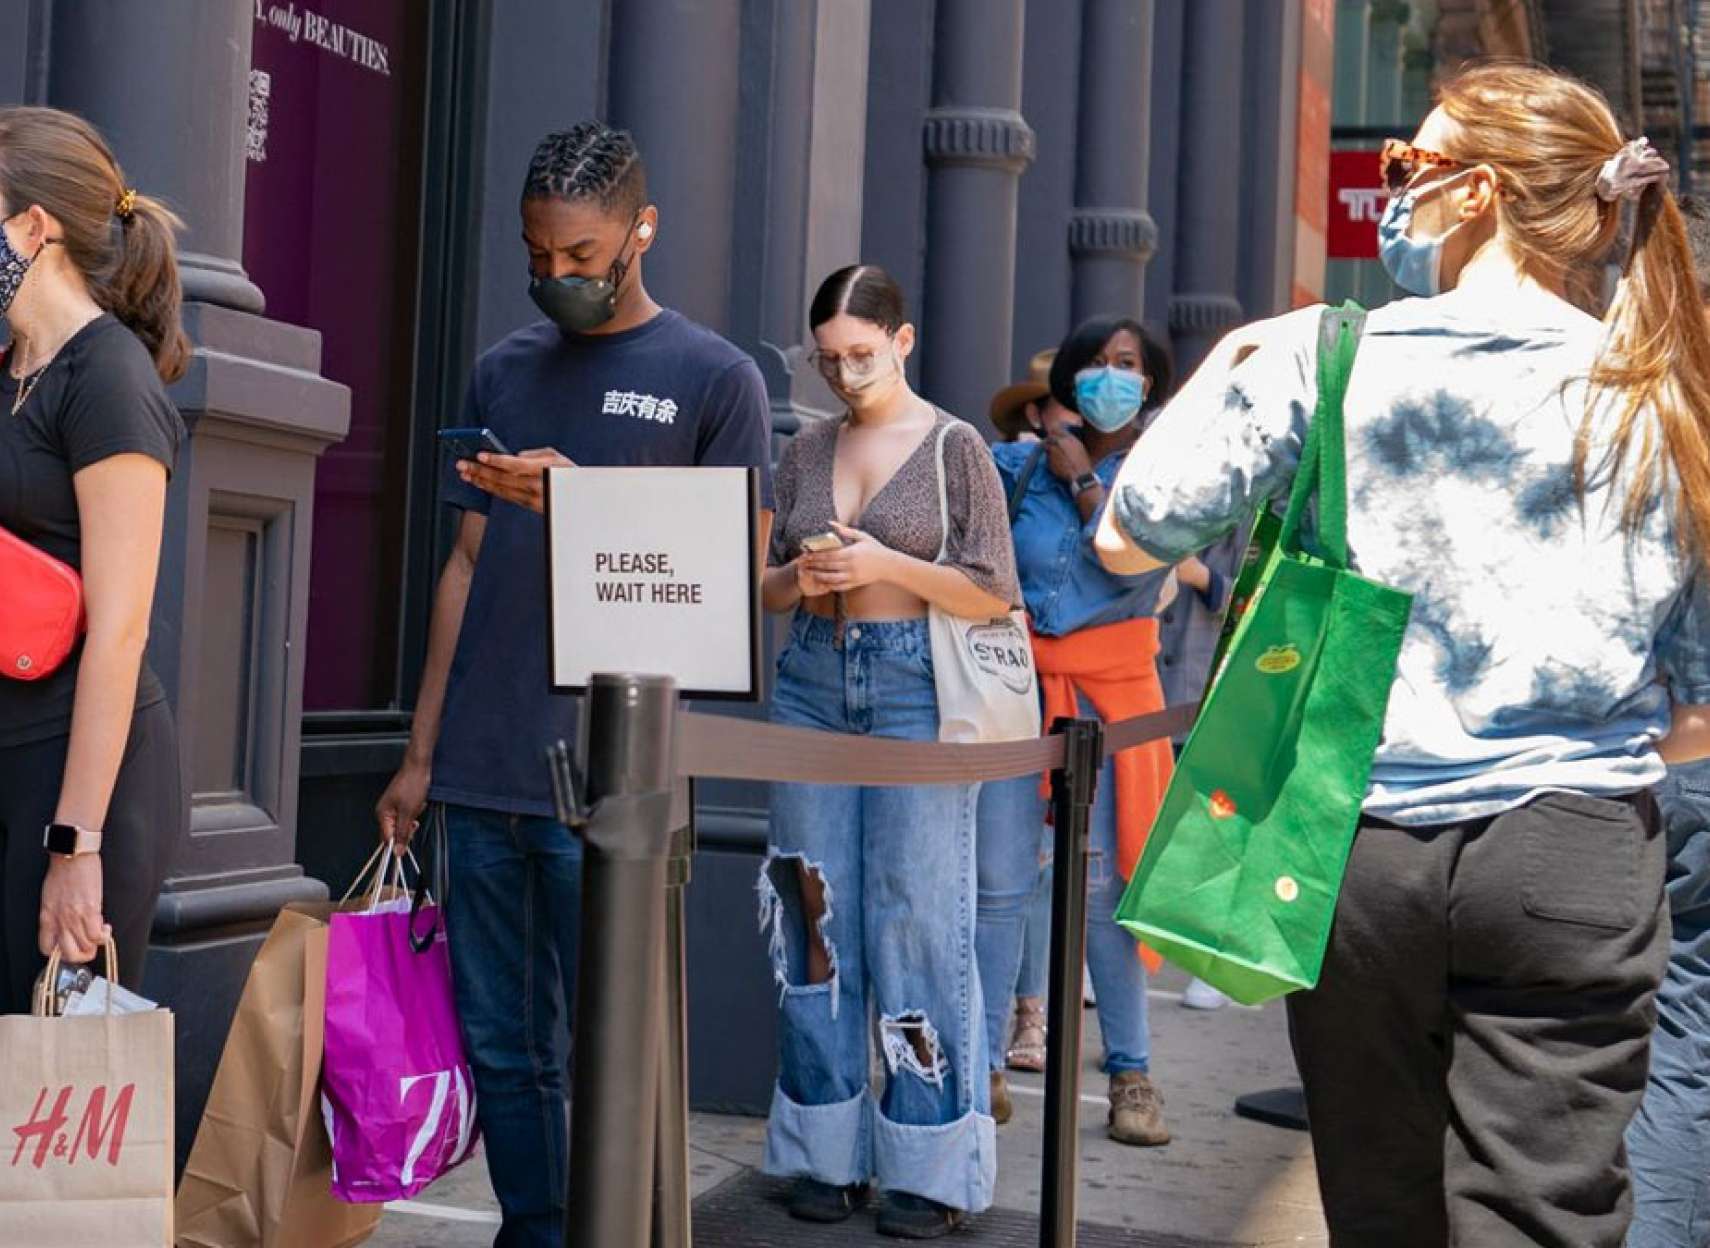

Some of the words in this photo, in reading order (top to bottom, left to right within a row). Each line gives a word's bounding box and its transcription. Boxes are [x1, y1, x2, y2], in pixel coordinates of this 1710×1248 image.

[268, 2, 302, 42] only
[602, 389, 678, 424] 吉庆有余
[595, 552, 674, 577] PLEASE,
[596, 582, 645, 604] WAIT
[651, 583, 702, 604] HERE
[12, 1083, 135, 1168] H&M
